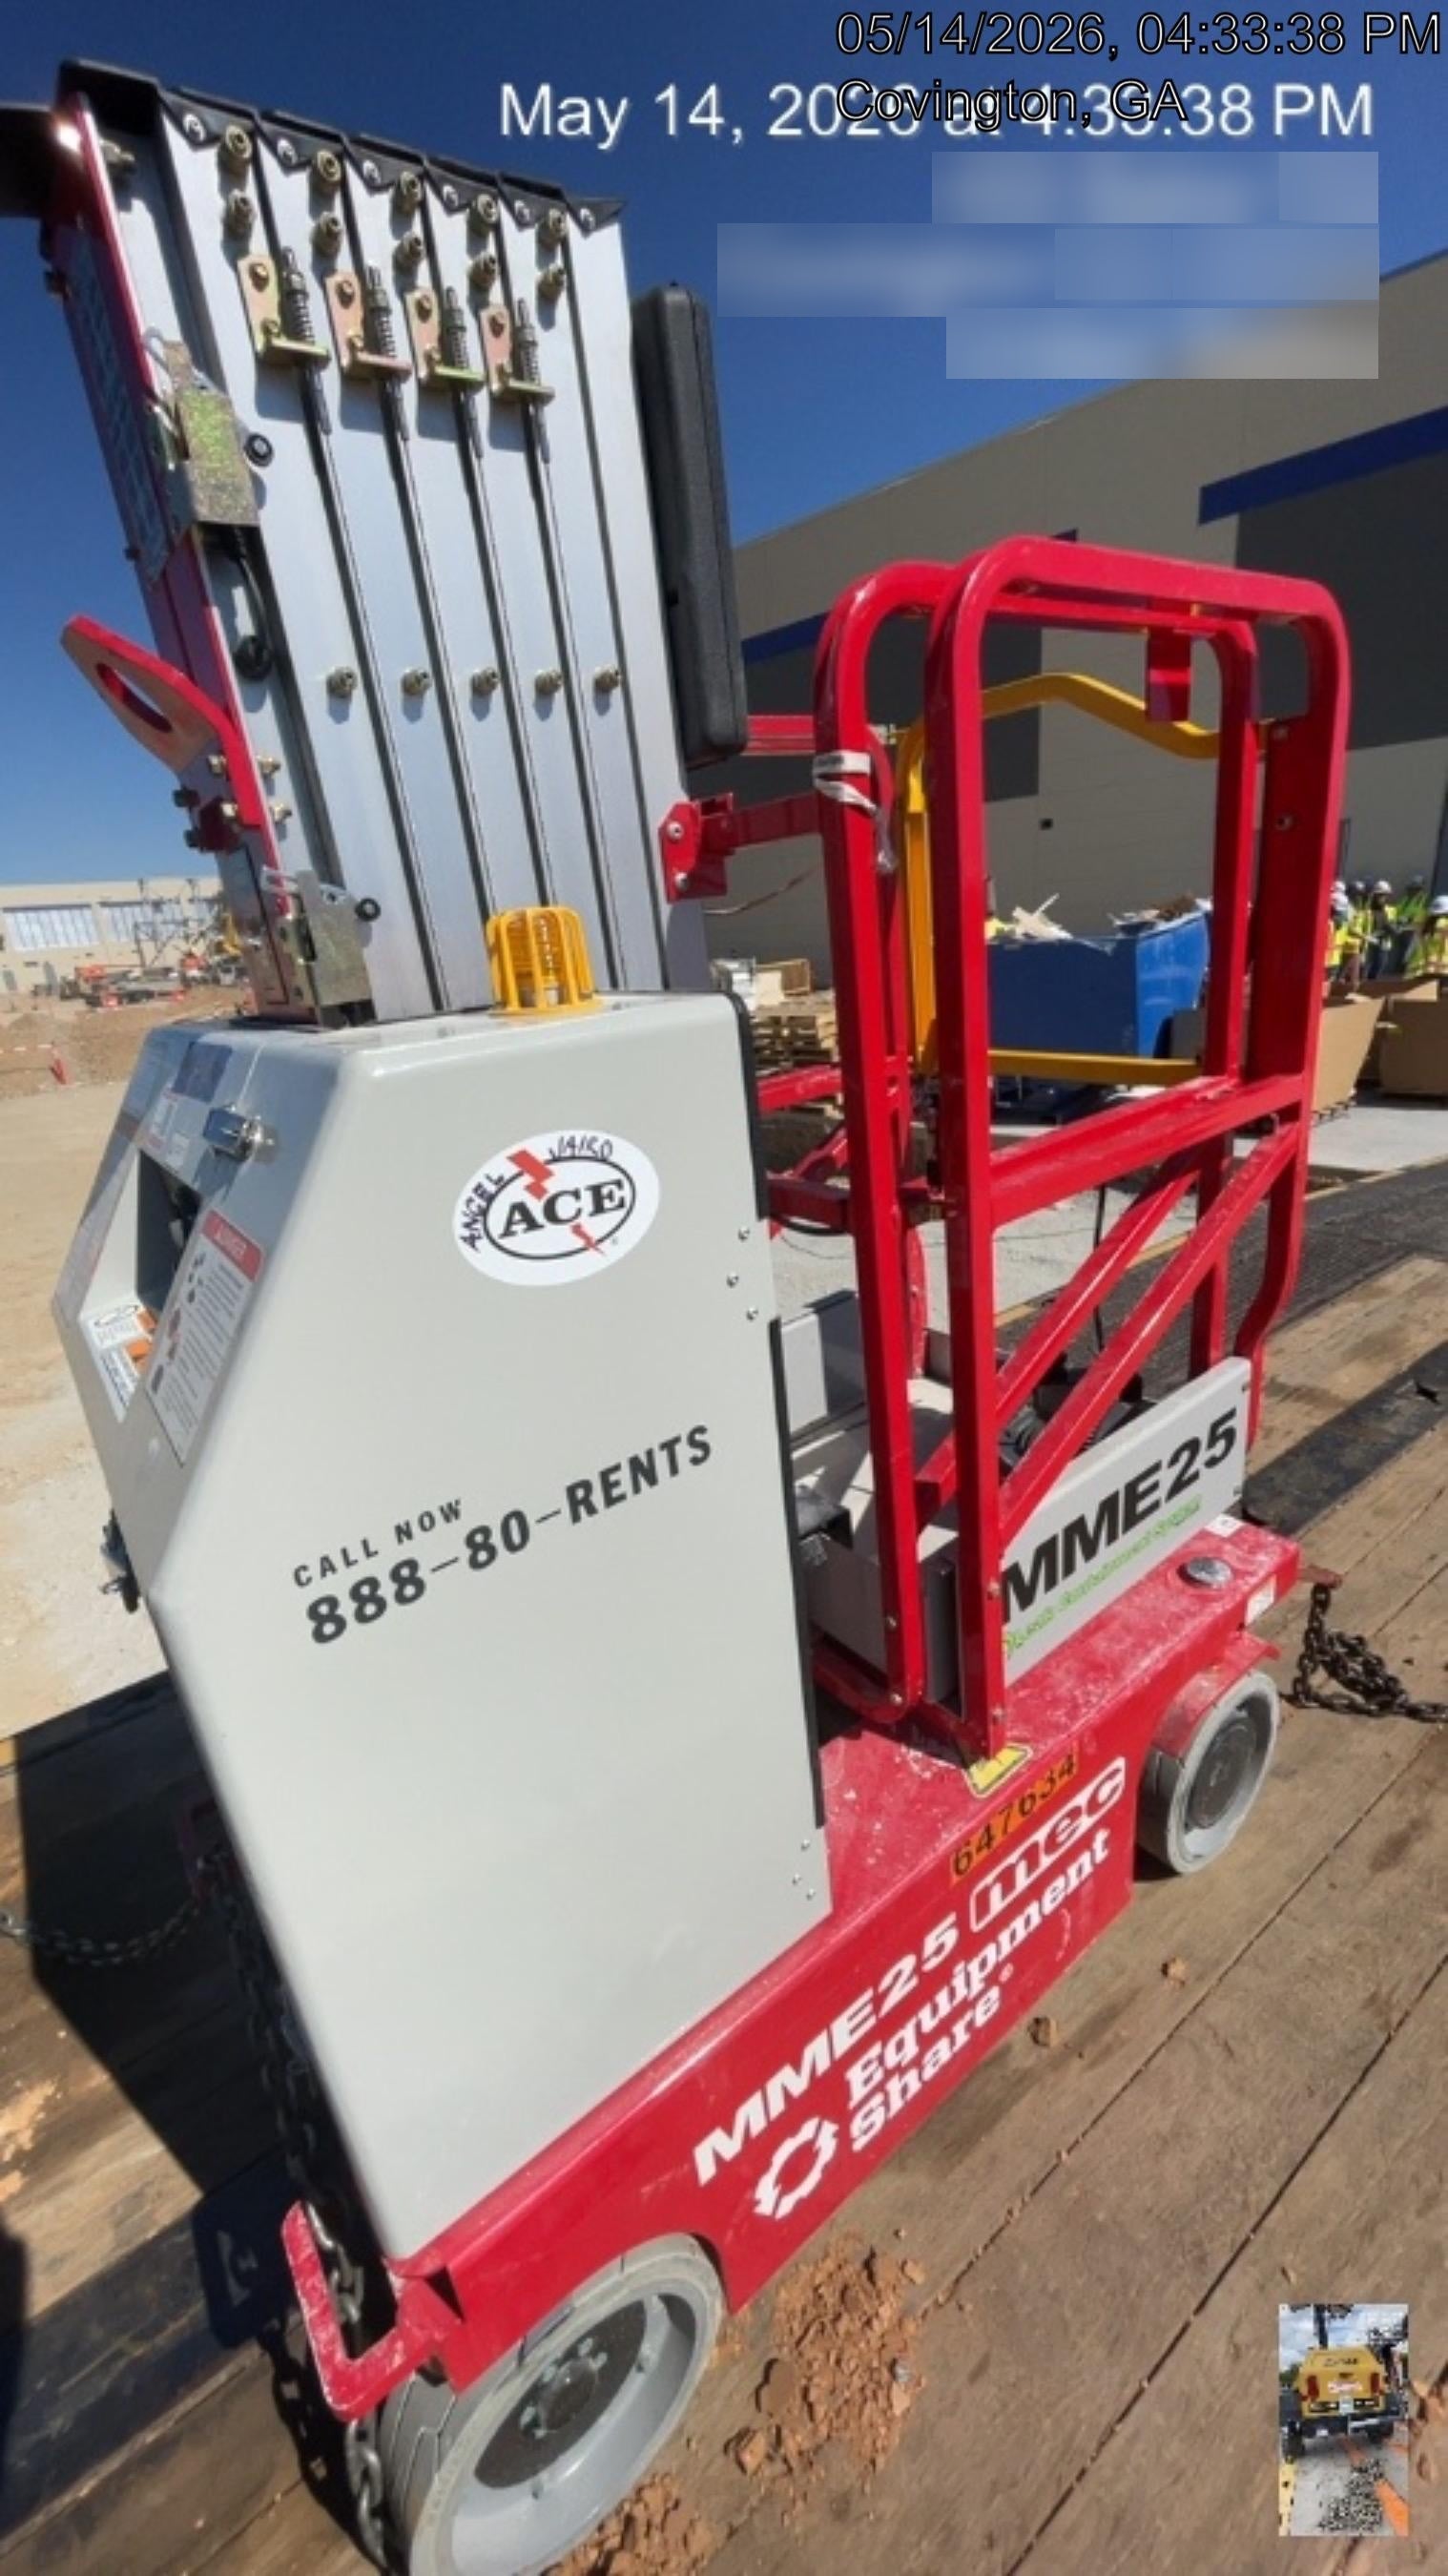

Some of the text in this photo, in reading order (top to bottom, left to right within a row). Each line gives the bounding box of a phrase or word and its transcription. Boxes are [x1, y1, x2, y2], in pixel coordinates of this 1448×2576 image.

[498, 1178, 626, 1238] ACE
[293, 1499, 463, 1588] CALL NOW
[1002, 1406, 1237, 1622] MME25
[693, 1912, 959, 2187] MME25
[845, 1829, 1110, 2109] Equipment
[851, 1986, 1002, 2153] Share
